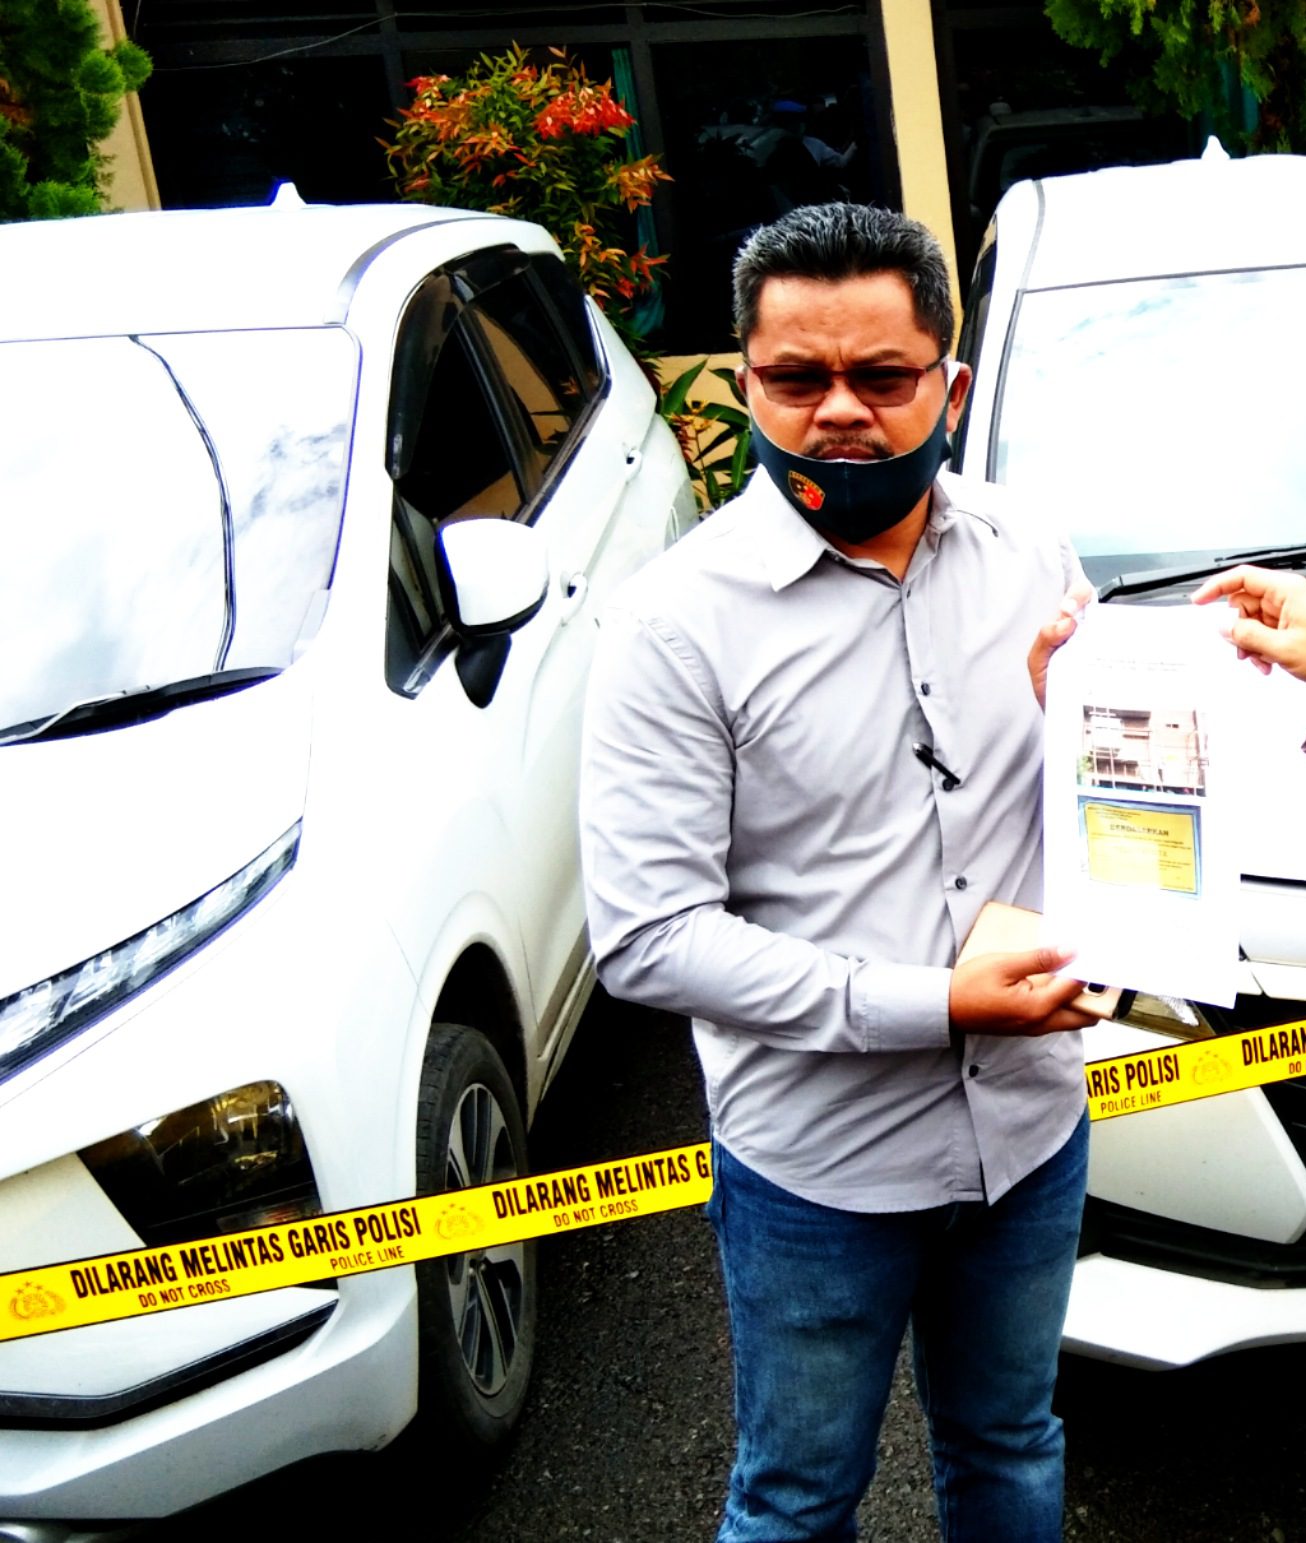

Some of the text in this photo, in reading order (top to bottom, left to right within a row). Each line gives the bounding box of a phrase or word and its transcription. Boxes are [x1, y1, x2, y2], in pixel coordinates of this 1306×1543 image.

[1125, 1053, 1180, 1091] POLISI
[1288, 1061, 1302, 1075] DO
[1101, 1091, 1161, 1114] POLICE LINE
[492, 1173, 592, 1220] DILARANG
[594, 1153, 691, 1200] MELINTAS
[553, 1199, 639, 1228] DO NOT CROSS
[70, 1207, 422, 1299] DILARANG MELINTAS GARIS POLISI
[330, 1245, 405, 1272] POLICE LINE
[138, 1279, 232, 1309] DO NOT CROSS
